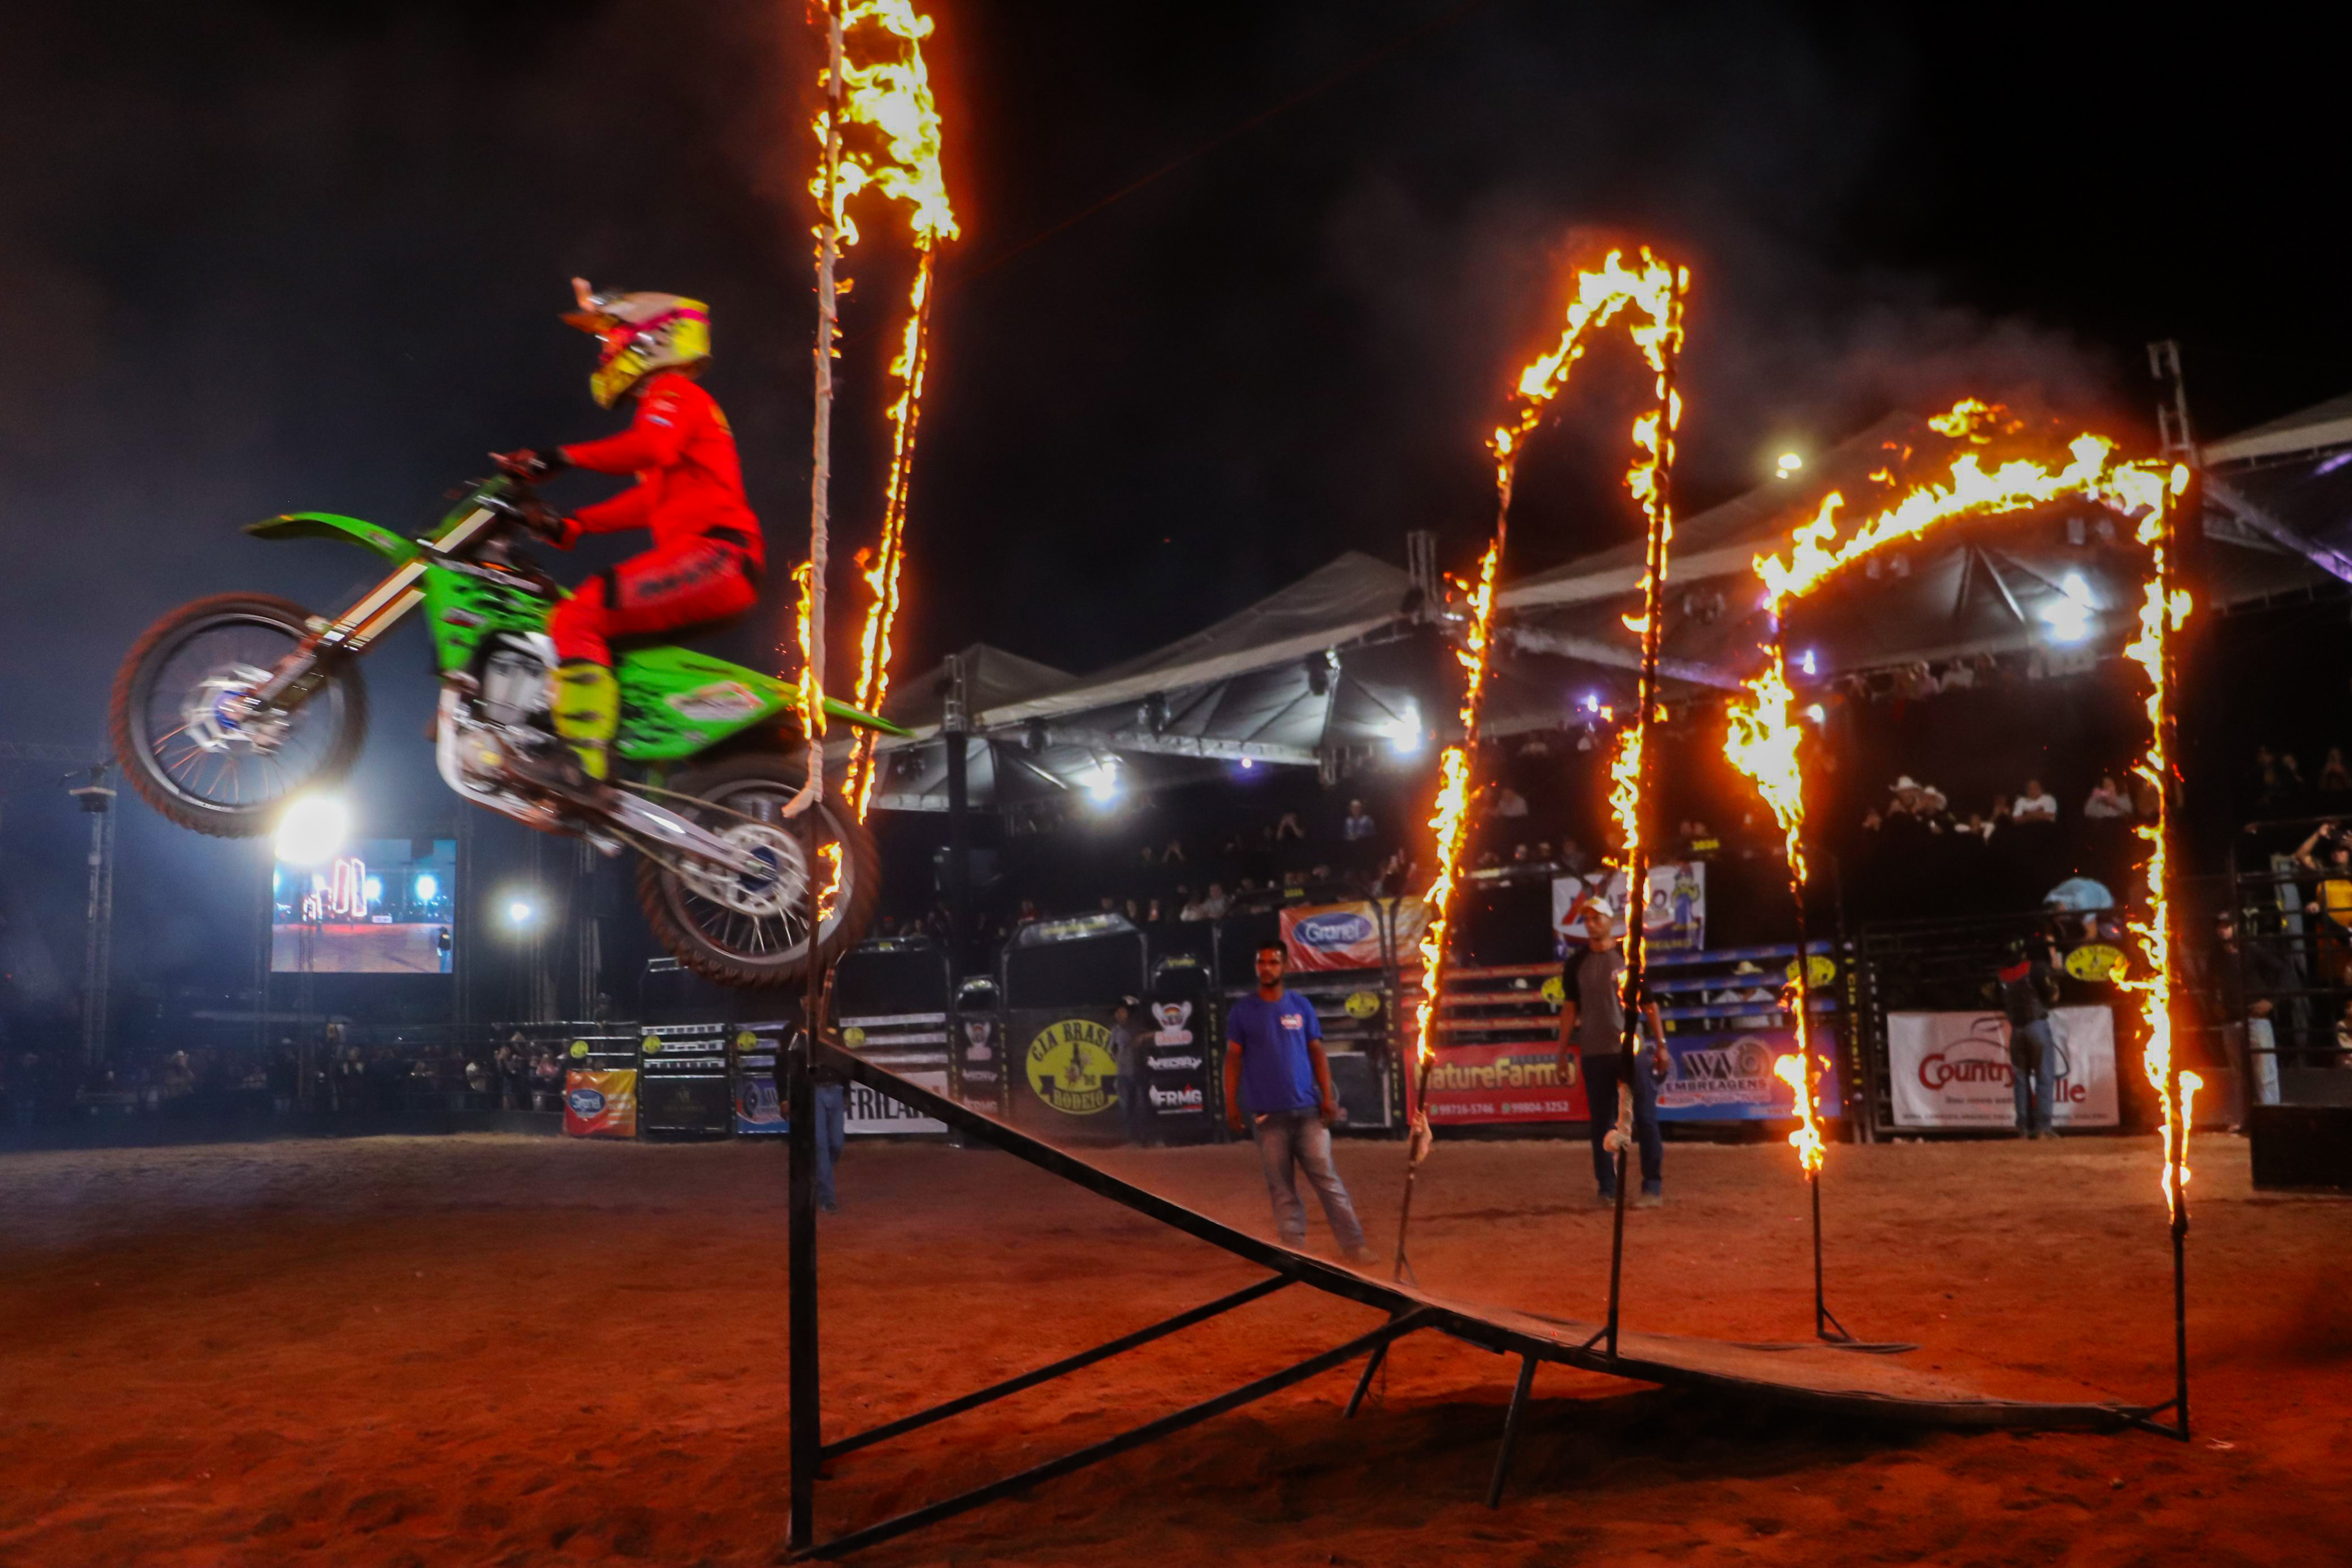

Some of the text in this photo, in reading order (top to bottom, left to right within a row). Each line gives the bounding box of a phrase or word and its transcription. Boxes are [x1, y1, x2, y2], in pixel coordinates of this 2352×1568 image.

[1032, 1022, 1112, 1062] CIA BRASI
[1666, 1079, 1766, 1091] EMBREAGENS
